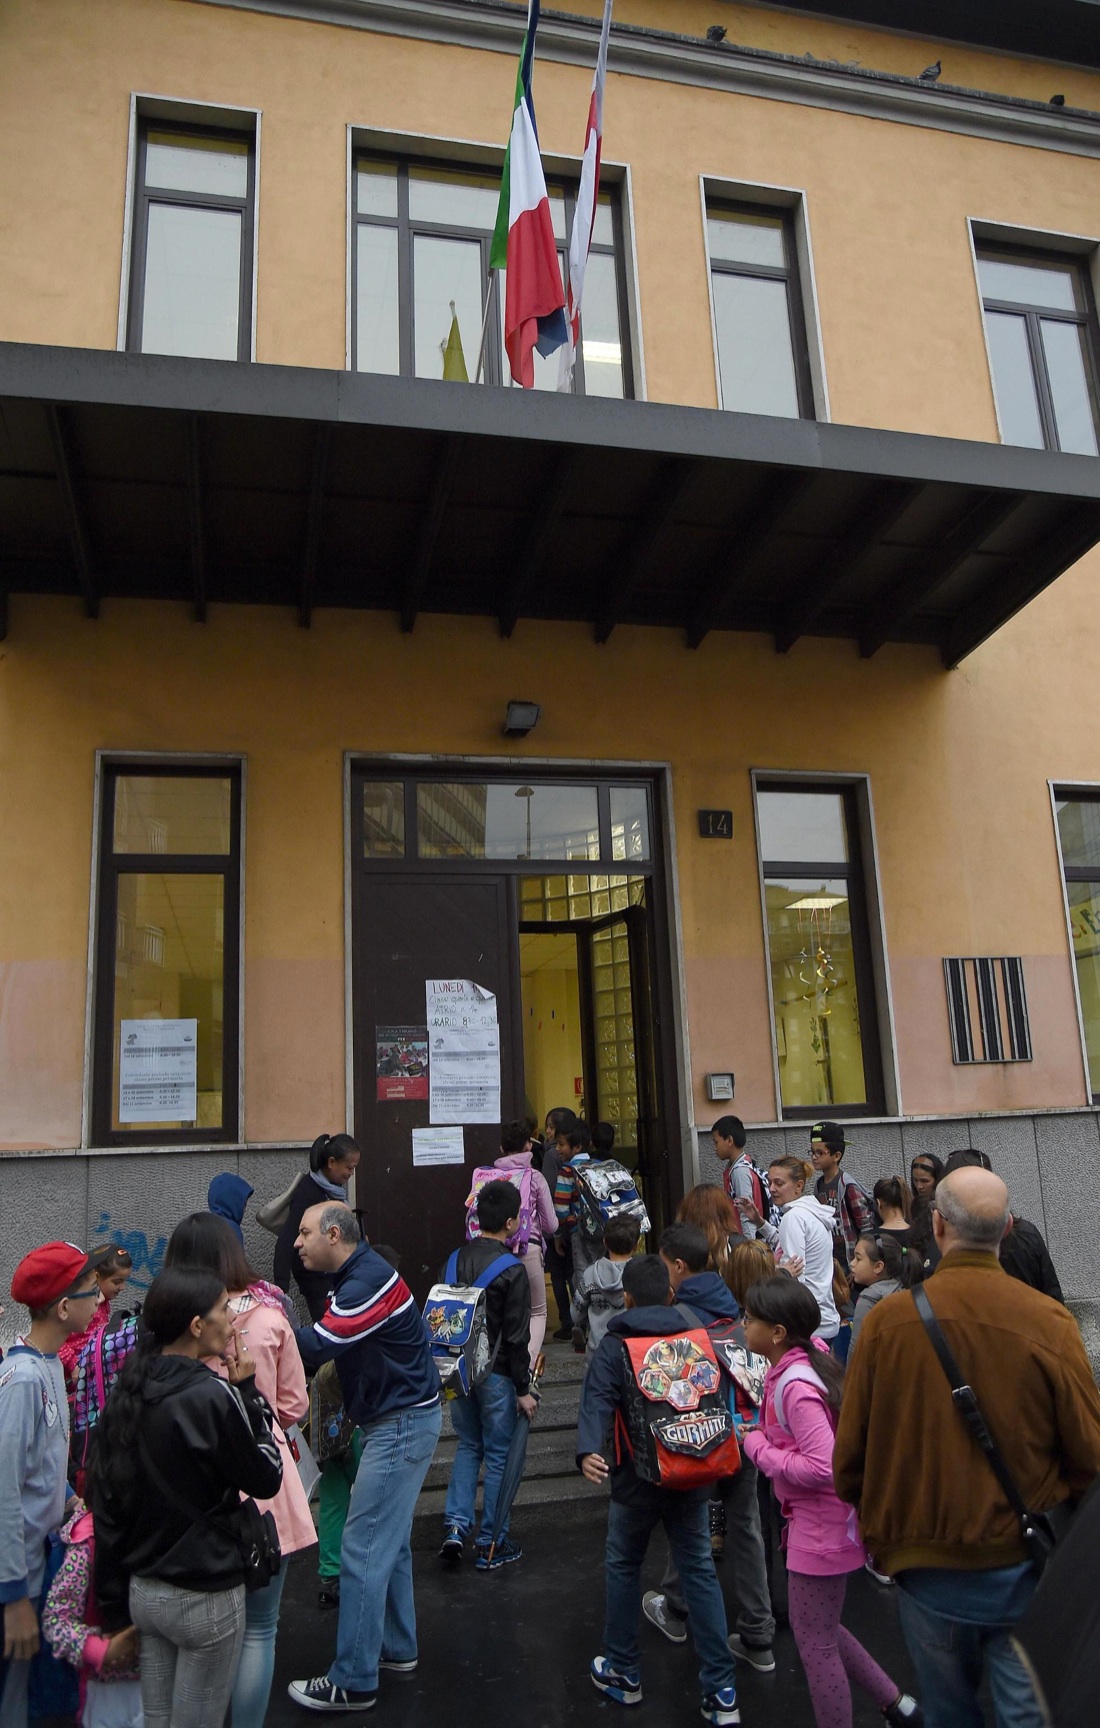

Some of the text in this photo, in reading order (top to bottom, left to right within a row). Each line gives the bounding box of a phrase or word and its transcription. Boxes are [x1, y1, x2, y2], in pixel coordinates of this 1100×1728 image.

[708, 814, 728, 835] 14
[431, 1017, 457, 1027] ORARIO
[667, 1418, 723, 1446] GORMITI
